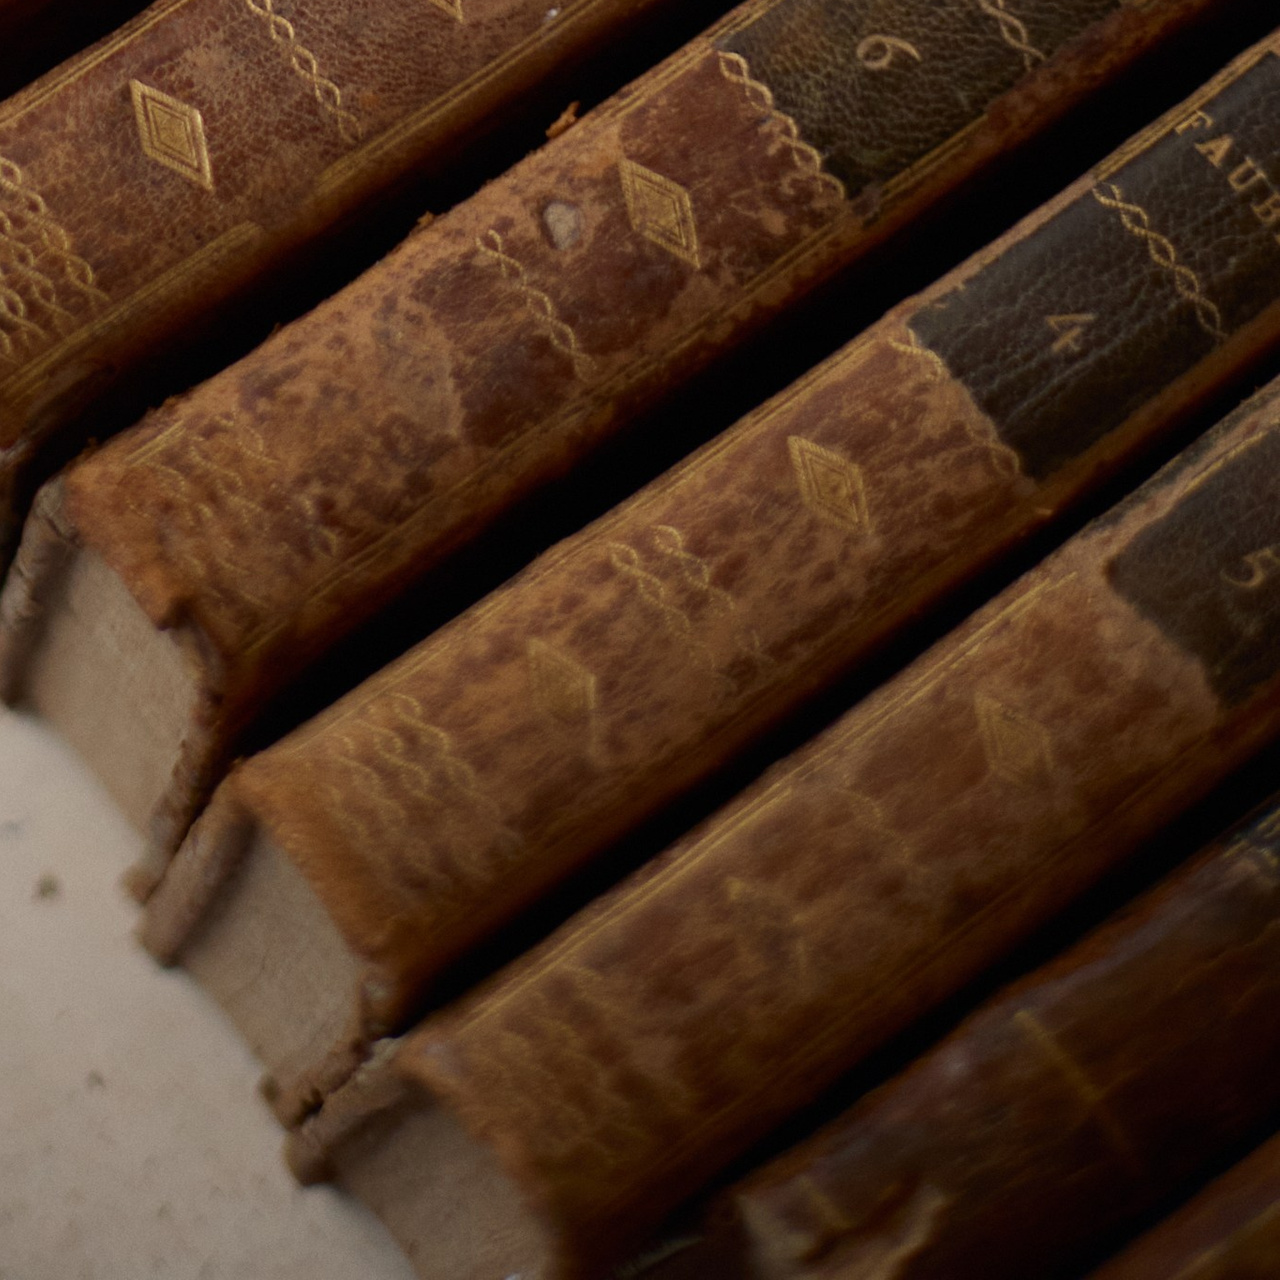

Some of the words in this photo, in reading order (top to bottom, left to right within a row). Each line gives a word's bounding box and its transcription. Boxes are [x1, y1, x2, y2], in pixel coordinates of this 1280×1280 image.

[855, 34, 921, 70] 6
[1174, 108, 1280, 246] FAUB
[1044, 312, 1098, 355] 4
[1221, 545, 1280, 589] 5
